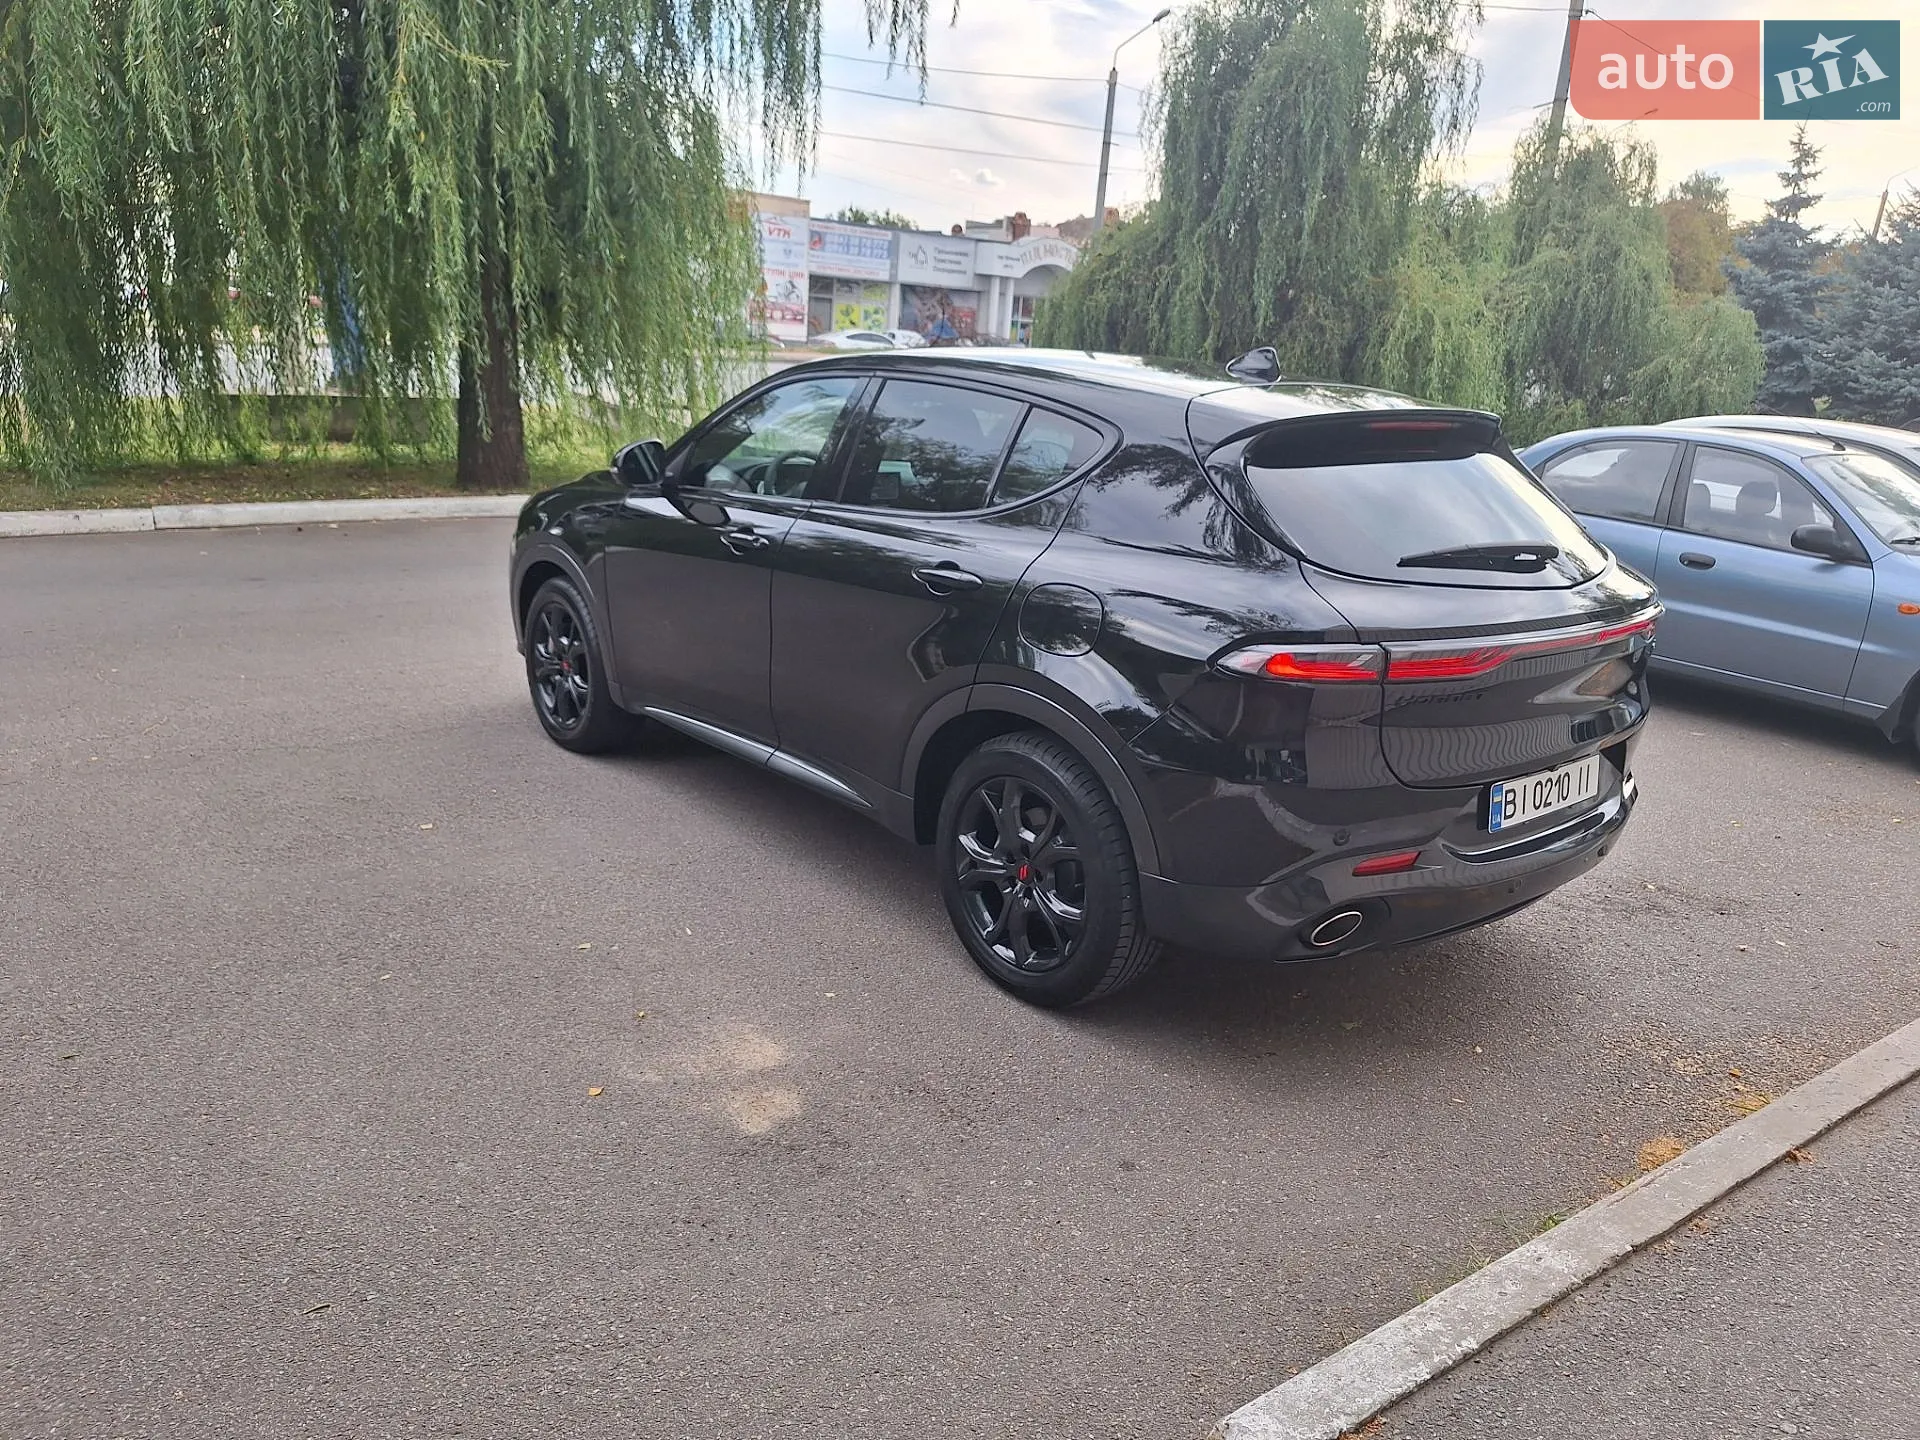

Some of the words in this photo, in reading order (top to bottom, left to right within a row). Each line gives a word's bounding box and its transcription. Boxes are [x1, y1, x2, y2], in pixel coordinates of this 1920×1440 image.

[1504, 784, 1527, 820] BI
[1532, 771, 1571, 811] 0210
[1578, 764, 1590, 796] II
[1492, 814, 1501, 825] UA
